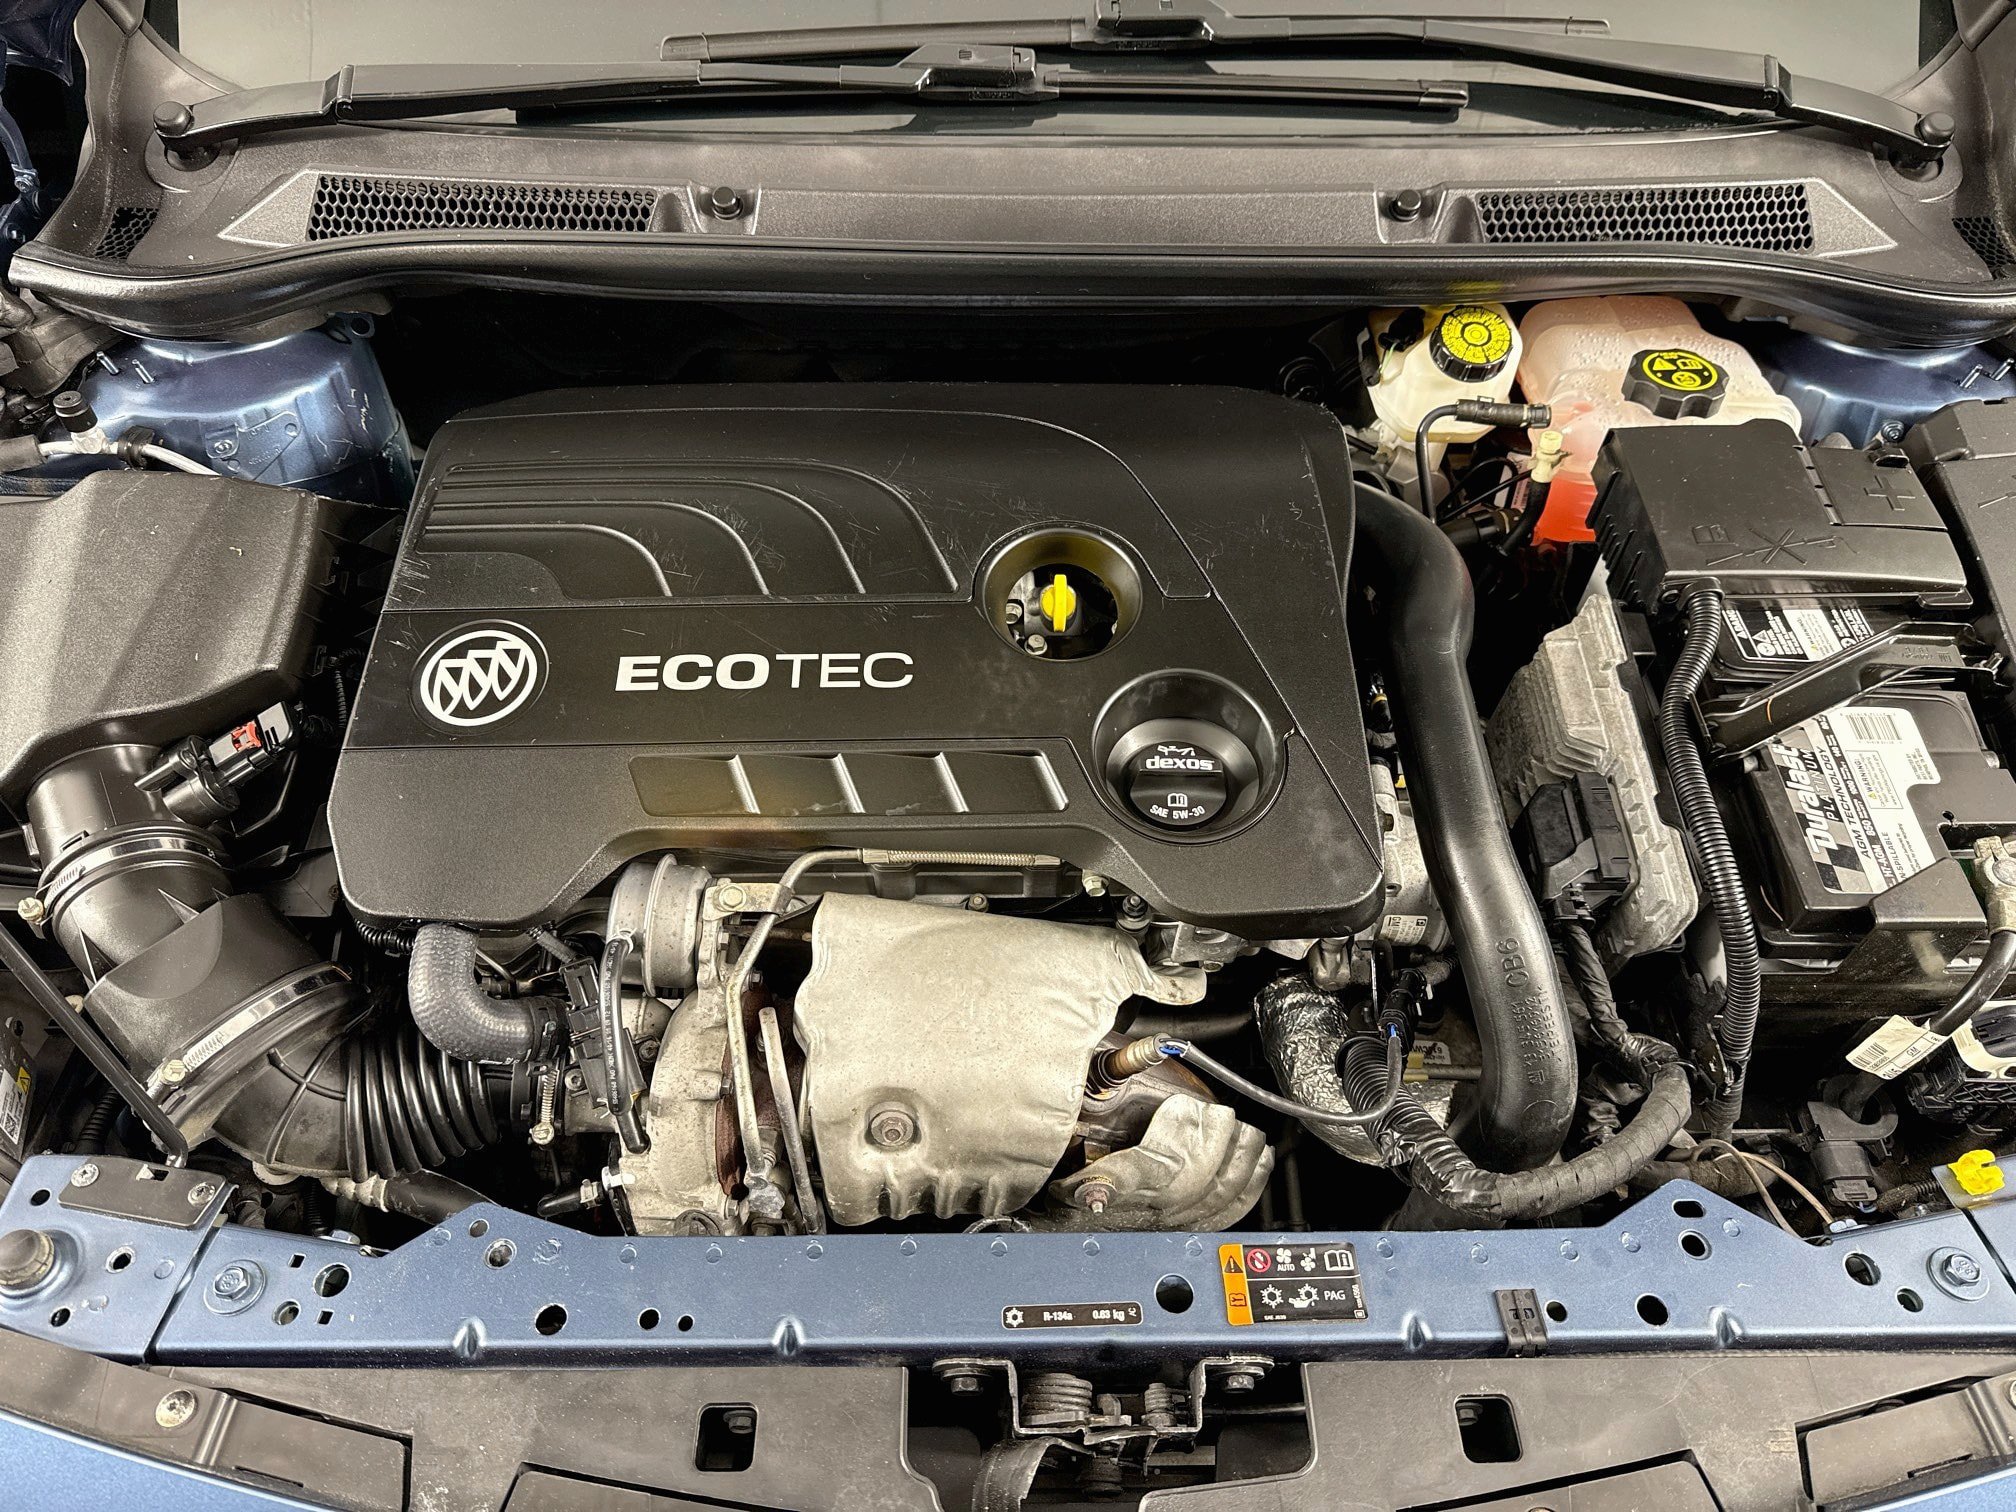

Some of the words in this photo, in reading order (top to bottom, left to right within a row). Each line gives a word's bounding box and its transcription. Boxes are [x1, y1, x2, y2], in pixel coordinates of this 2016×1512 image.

[615, 652, 914, 691] ECOTEC
[1146, 755, 1214, 770] dexos
[1801, 749, 1840, 821] PLATINUM
[1816, 746, 1858, 827] TECHNOLOGY
[1772, 744, 1840, 854] Duralast
[1150, 805, 1169, 818] SAE
[1172, 806, 1206, 819] 5W-30
[1861, 821, 1876, 837] 850
[1852, 829, 1872, 859] AGM
[1496, 937, 1530, 988] CB6
[1907, 1046, 1918, 1057] GM
[1277, 1263, 1296, 1272] AUTO
[1324, 1290, 1346, 1301] PAG
[1043, 1311, 1073, 1321] R-134a
[1092, 1309, 1111, 1320] 0.63
[1112, 1309, 1125, 1322] kg
